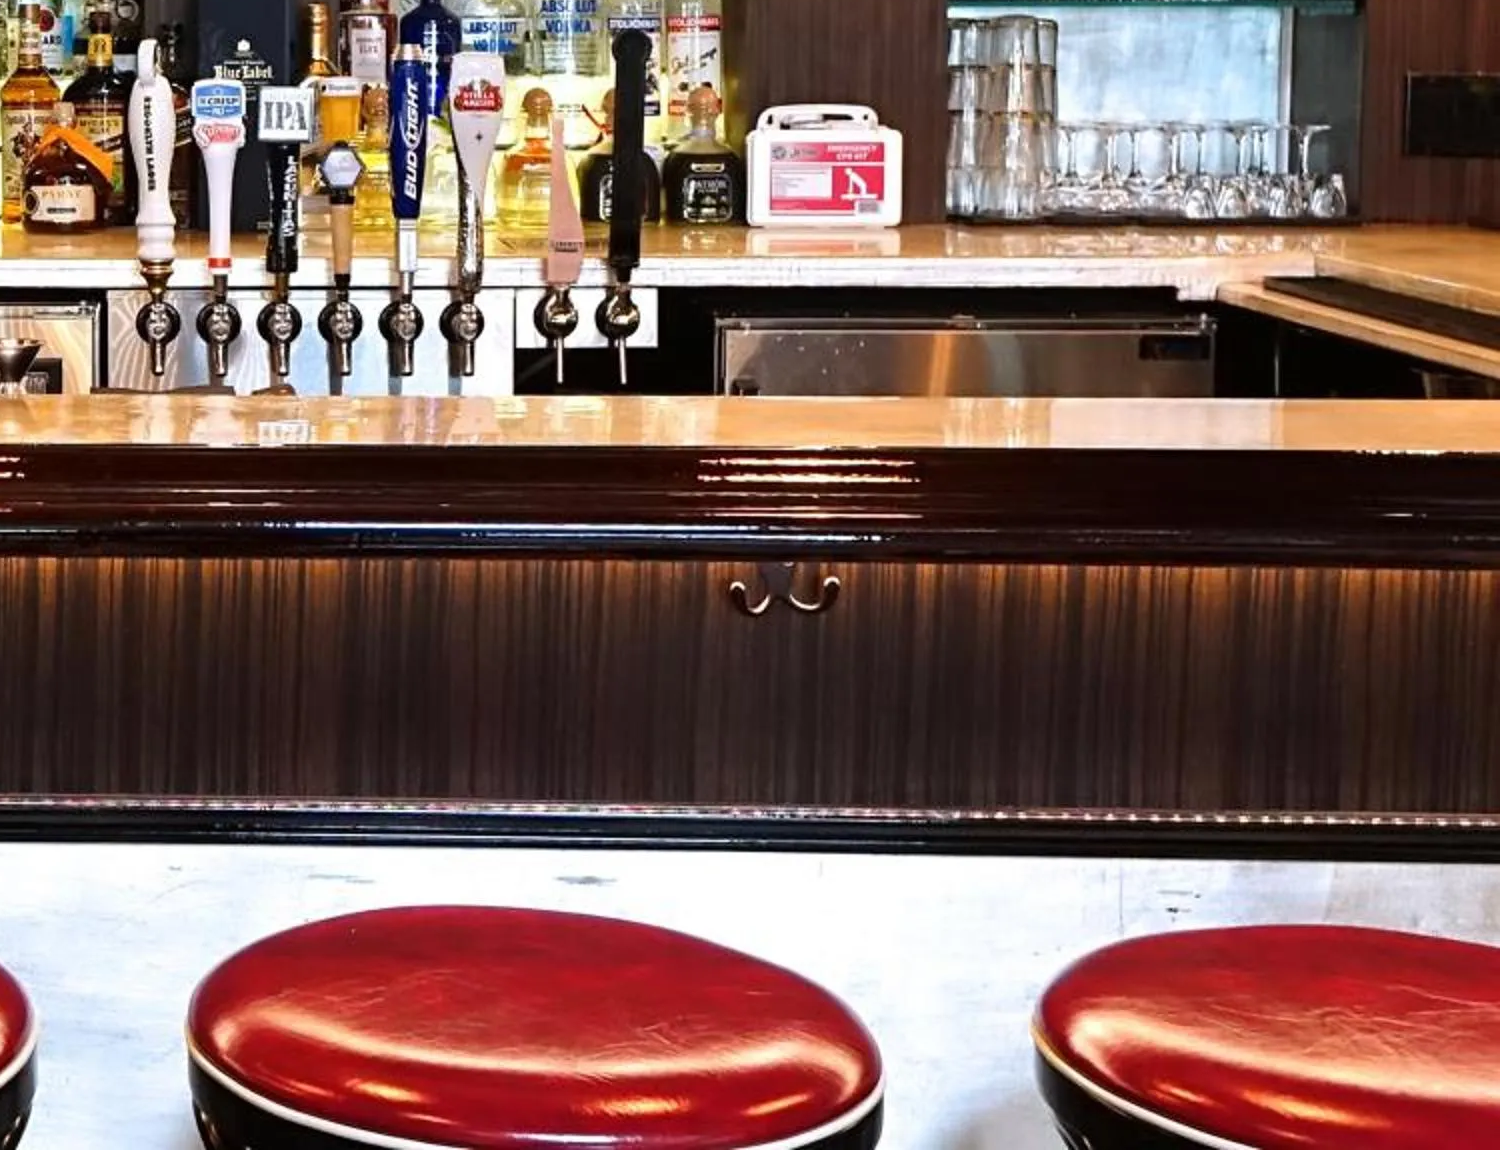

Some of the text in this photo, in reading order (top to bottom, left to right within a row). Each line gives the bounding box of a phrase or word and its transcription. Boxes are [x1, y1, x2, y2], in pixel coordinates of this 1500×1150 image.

[540, 0, 597, 13] ABSOLUT
[469, 22, 518, 34] ABSOLUT
[213, 65, 274, 79] Blue Label
[207, 97, 239, 106] CRISP
[263, 101, 307, 131] IPA
[143, 96, 157, 192] BROOKLYN LAGER
[404, 153, 418, 201] BUD
[281, 155, 300, 238] LAGUNITAS
